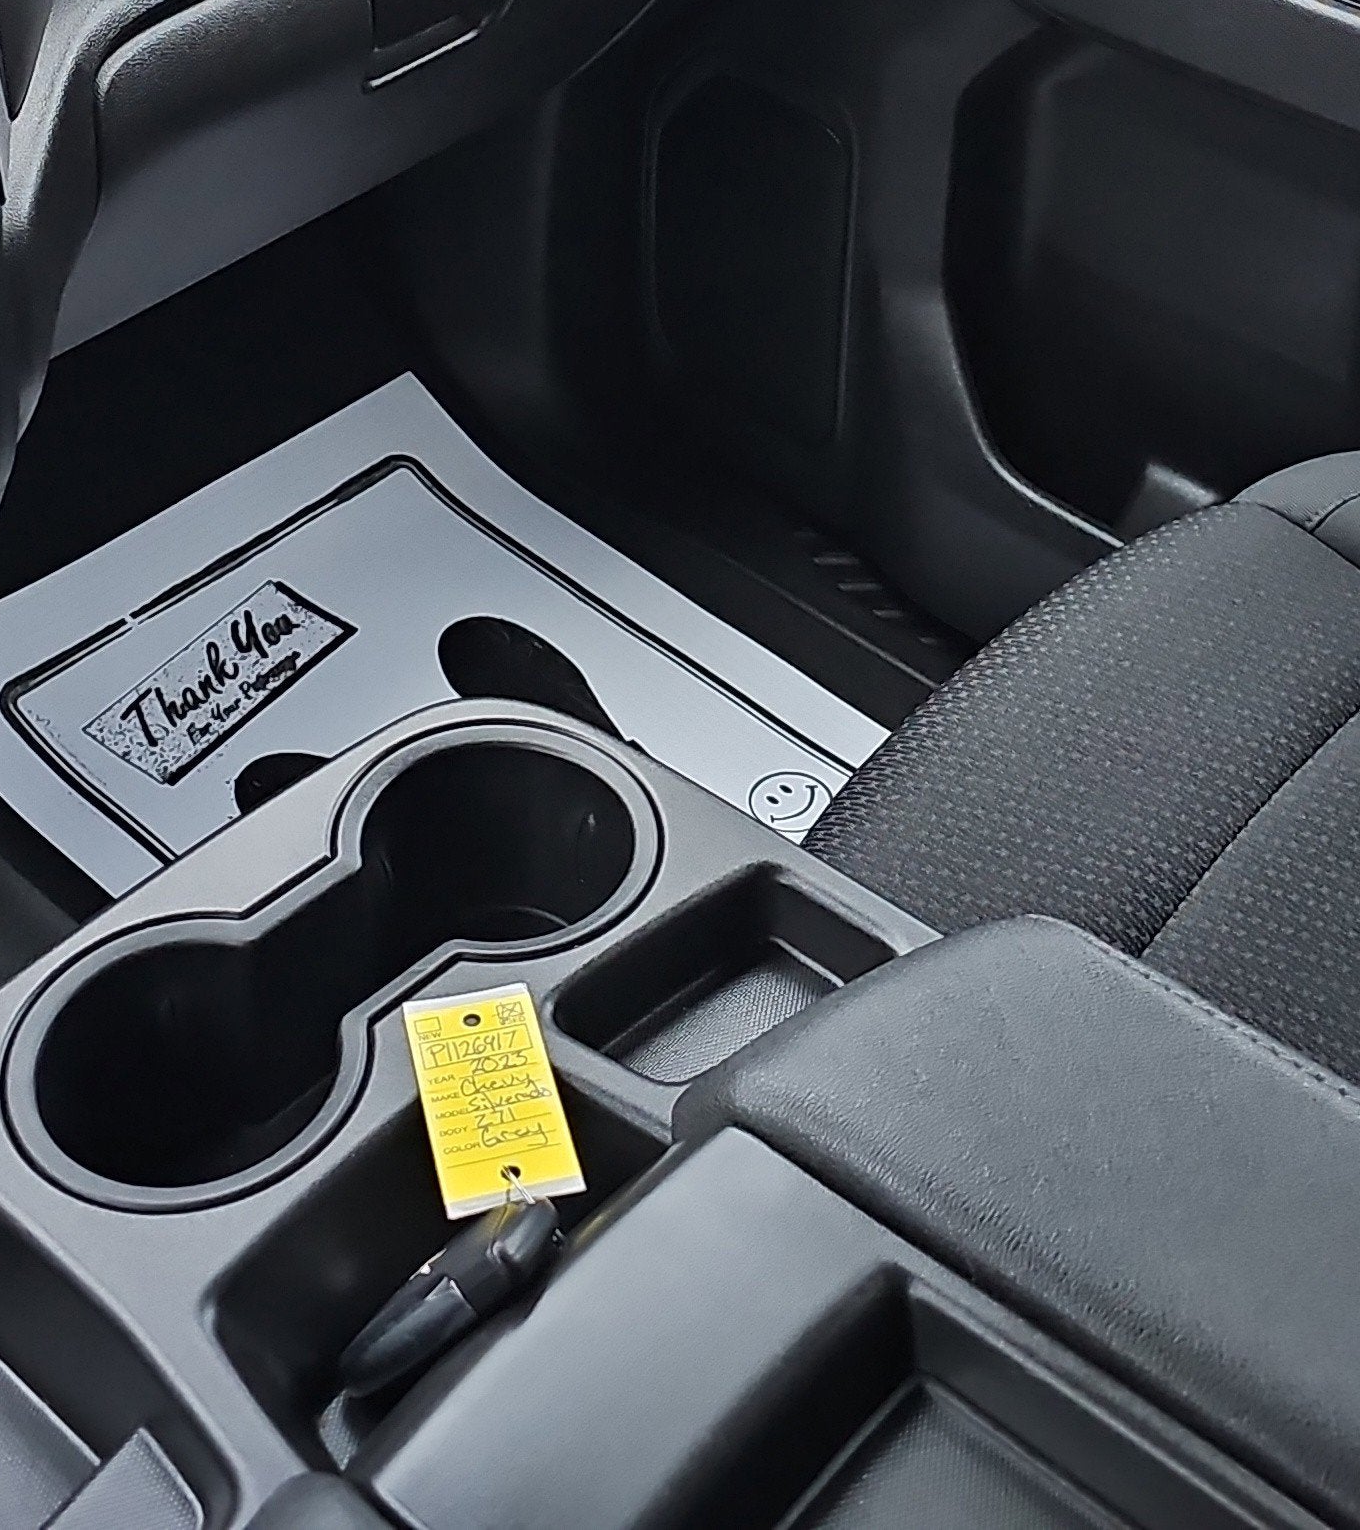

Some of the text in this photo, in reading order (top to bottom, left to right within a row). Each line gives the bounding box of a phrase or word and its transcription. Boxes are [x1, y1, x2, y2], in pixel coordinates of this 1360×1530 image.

[120, 609, 301, 748] Thank You
[418, 1031, 441, 1041] NEW
[427, 1074, 456, 1085] YEAR
[430, 1091, 460, 1103] MAKE
[443, 1141, 481, 1155] COLOR
